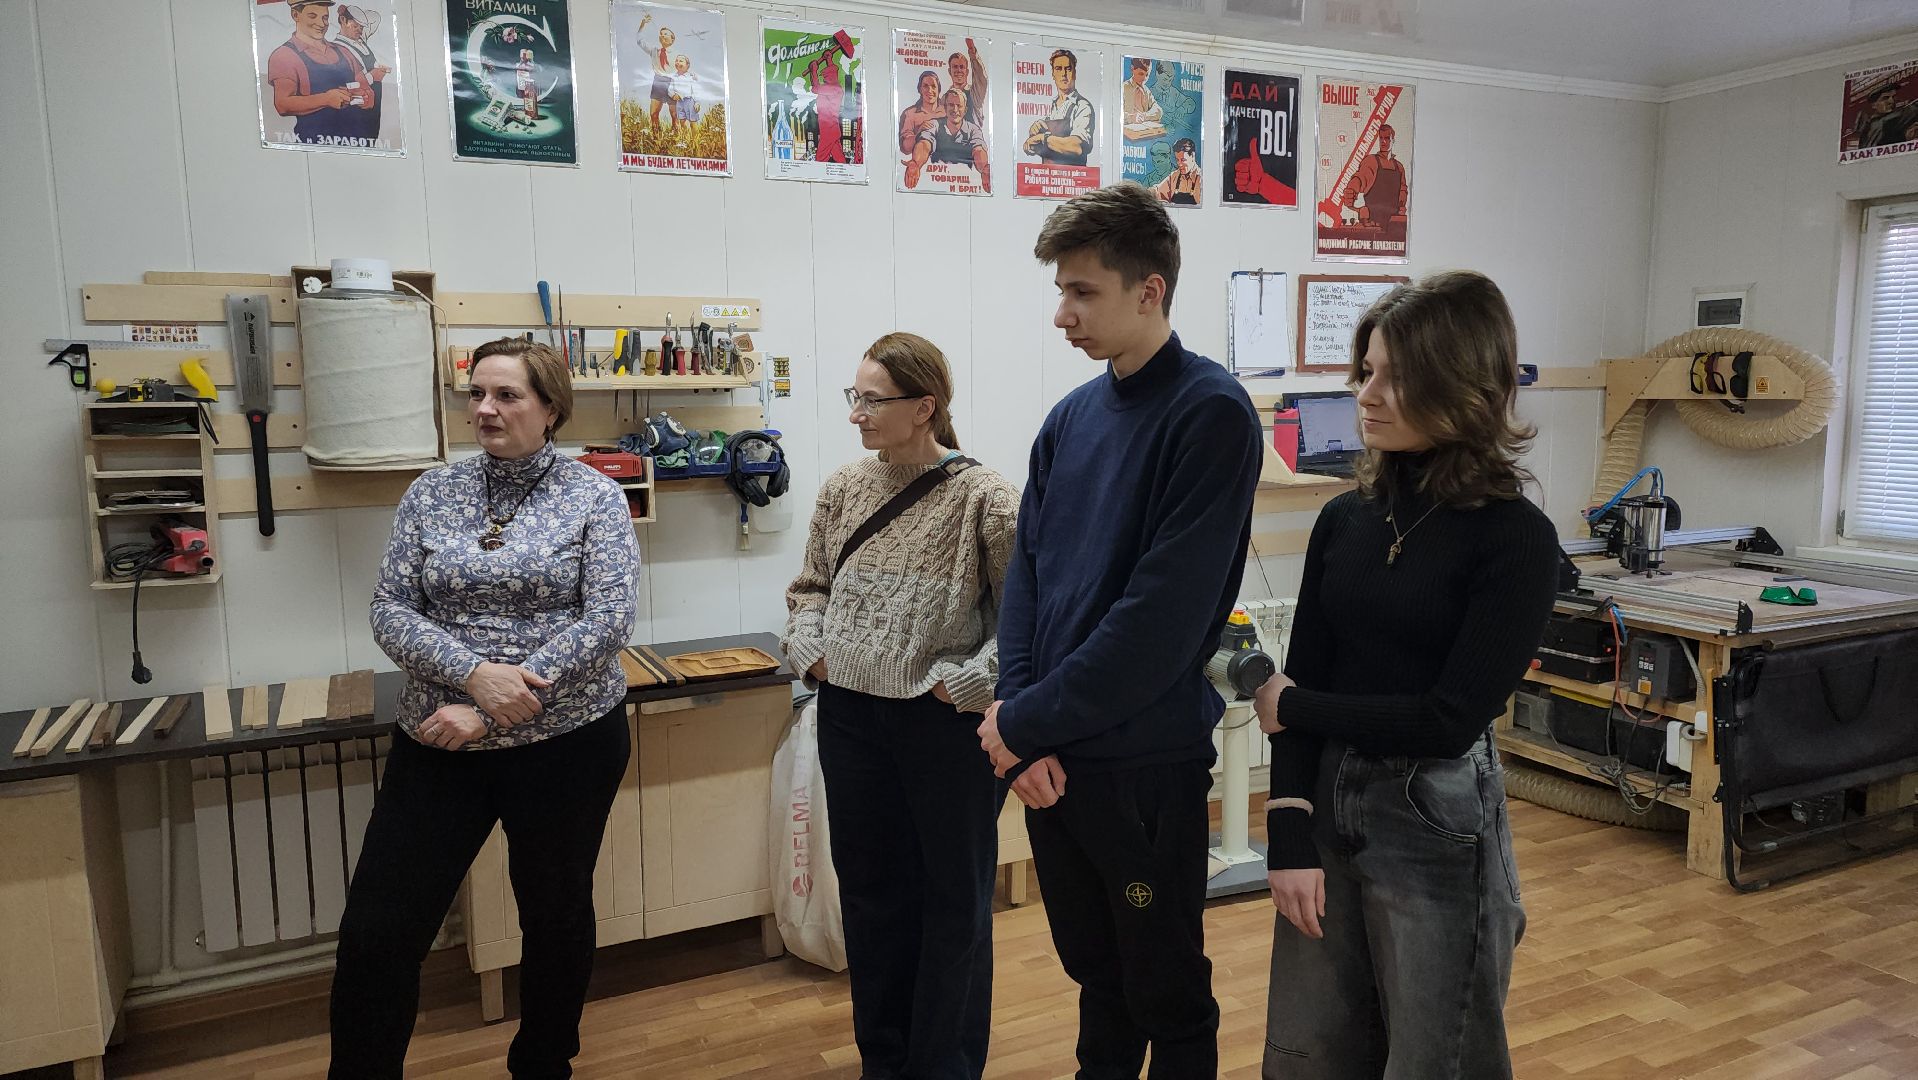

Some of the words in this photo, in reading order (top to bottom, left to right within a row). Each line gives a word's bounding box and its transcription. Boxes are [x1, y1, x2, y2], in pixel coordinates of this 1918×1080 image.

[465, 0, 537, 15] ВИТАМИН
[896, 48, 929, 58] ЧЕЛОВЕК
[1016, 61, 1045, 76] БЕРЕГИ
[1016, 82, 1053, 97] РАБОЧУЮ
[1229, 80, 1279, 103] ДАЙ
[1322, 83, 1360, 106] ВЫШЕ
[274, 131, 303, 143] ТАК
[316, 134, 392, 150] ЗАРАБОТАЛ
[1331, 118, 1381, 206] ПРОИЗВОДИТЕЛЬНОСТЬ
[1376, 91, 1395, 119] ТРУДА
[1840, 153, 1848, 162] А
[1849, 149, 1874, 161] КАК
[623, 154, 630, 166] И
[630, 155, 646, 167] МЫ
[647, 156, 675, 169] БУДЕМ
[675, 158, 729, 172] ЛЕТЧИКАМИ!
[930, 174, 970, 184] ТОВАРИЩ
